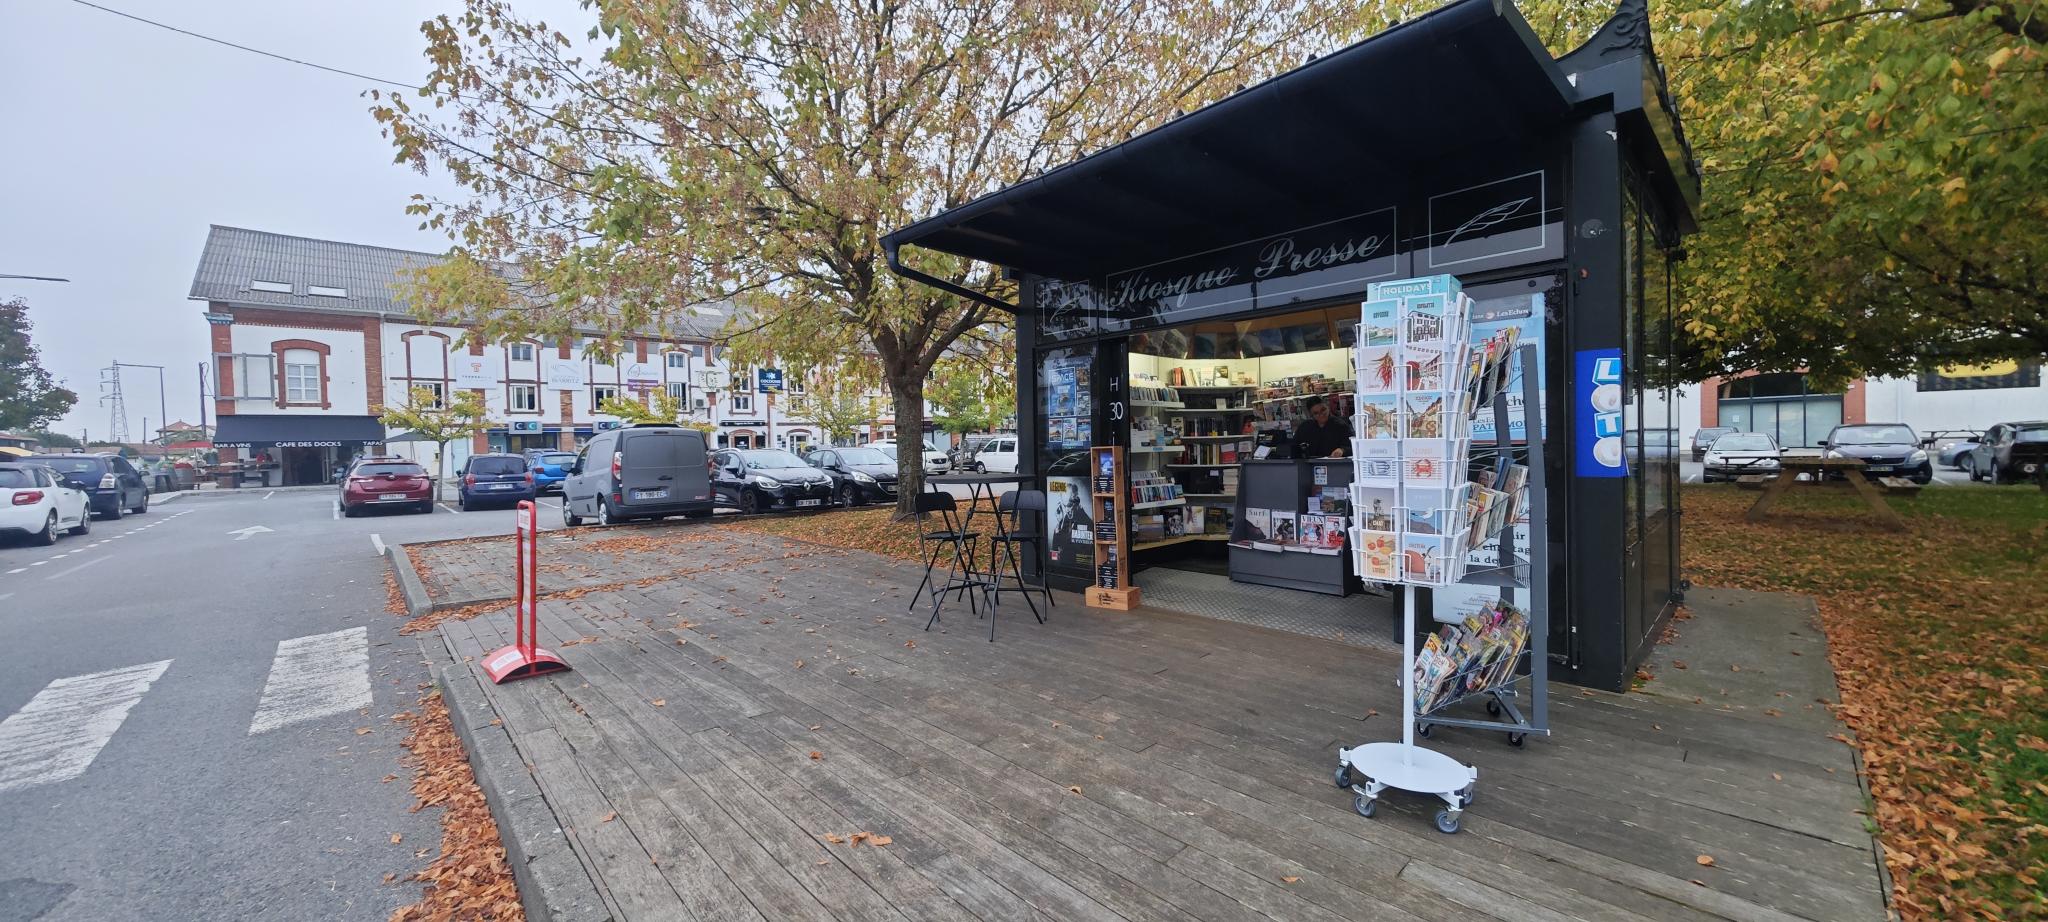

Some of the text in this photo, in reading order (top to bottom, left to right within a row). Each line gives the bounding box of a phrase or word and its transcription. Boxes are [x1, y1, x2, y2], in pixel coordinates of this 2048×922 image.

[1110, 233, 1391, 308] Kiosque Presse
[314, 440, 342, 448] DOCKS
